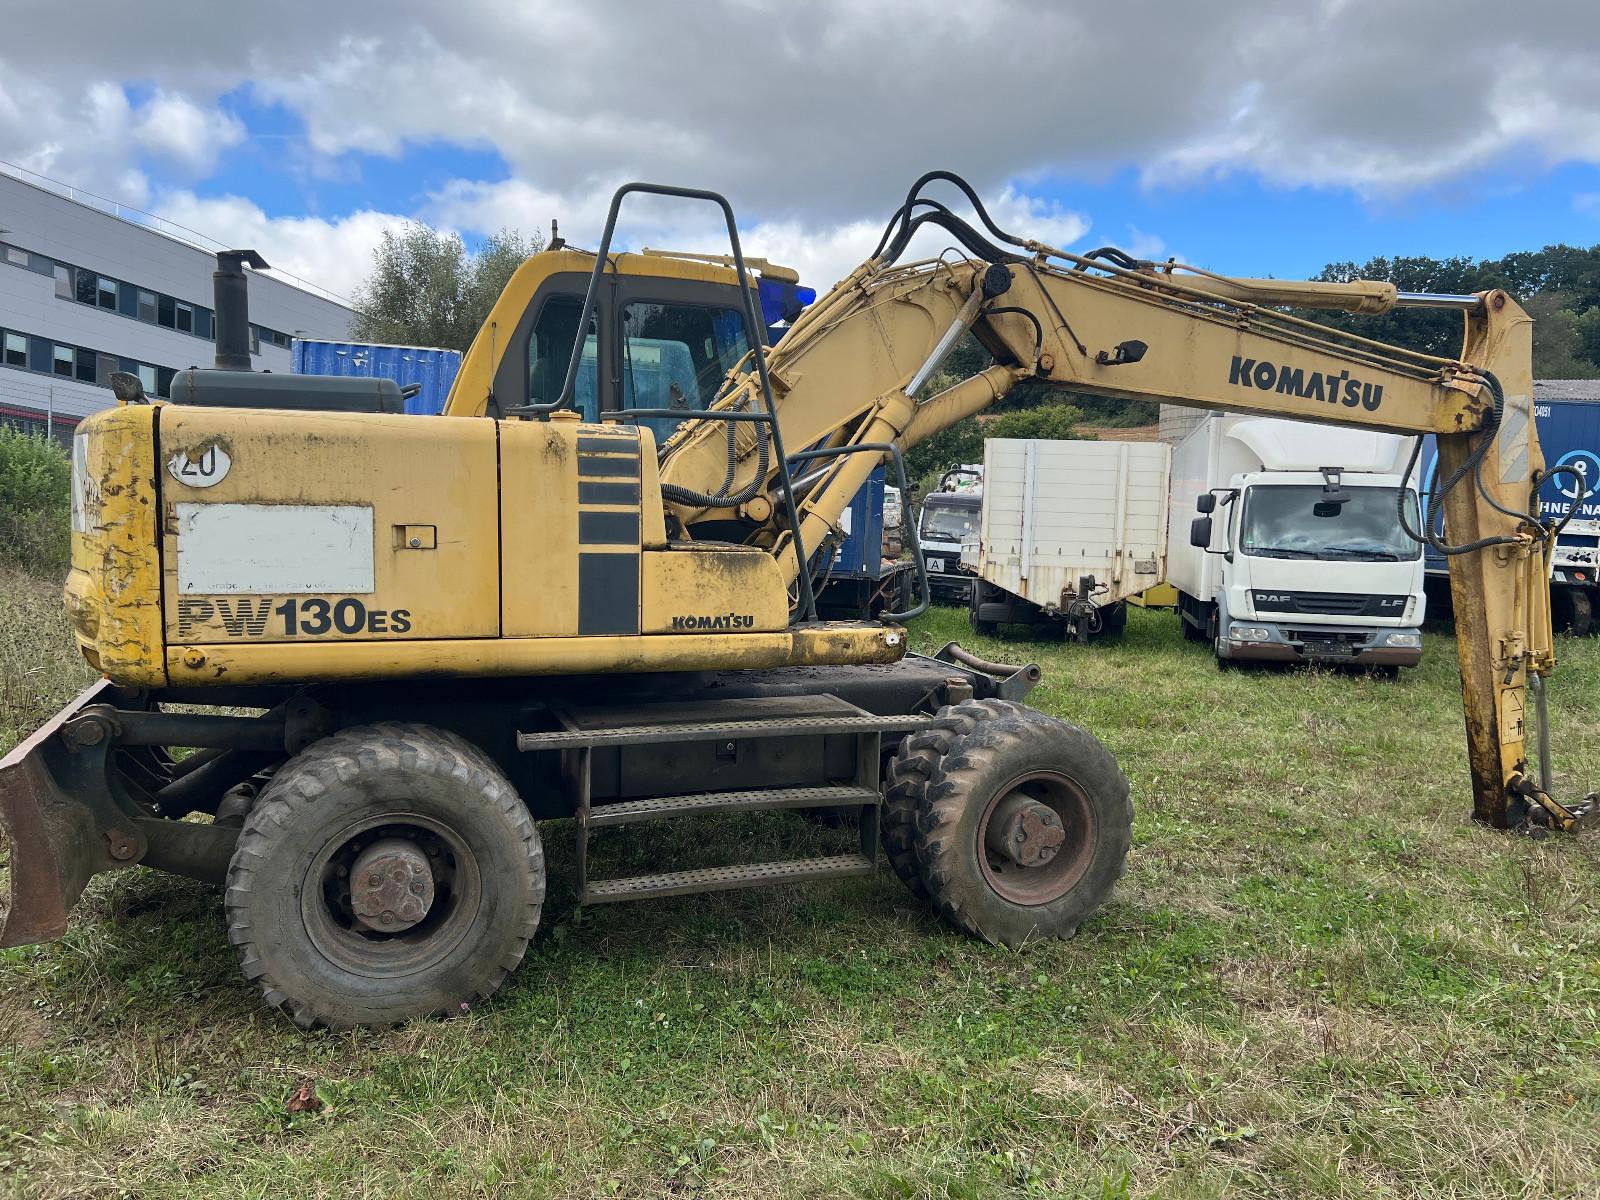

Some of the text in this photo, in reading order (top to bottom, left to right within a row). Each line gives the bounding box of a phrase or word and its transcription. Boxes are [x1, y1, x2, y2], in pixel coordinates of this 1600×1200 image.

[1228, 355, 1383, 411] KOMATSU
[1539, 501, 1600, 516] HNENA
[930, 559, 940, 570] A
[1255, 594, 1290, 602] DAF
[1380, 599, 1404, 607] LF
[672, 612, 754, 629] KOMATSU
